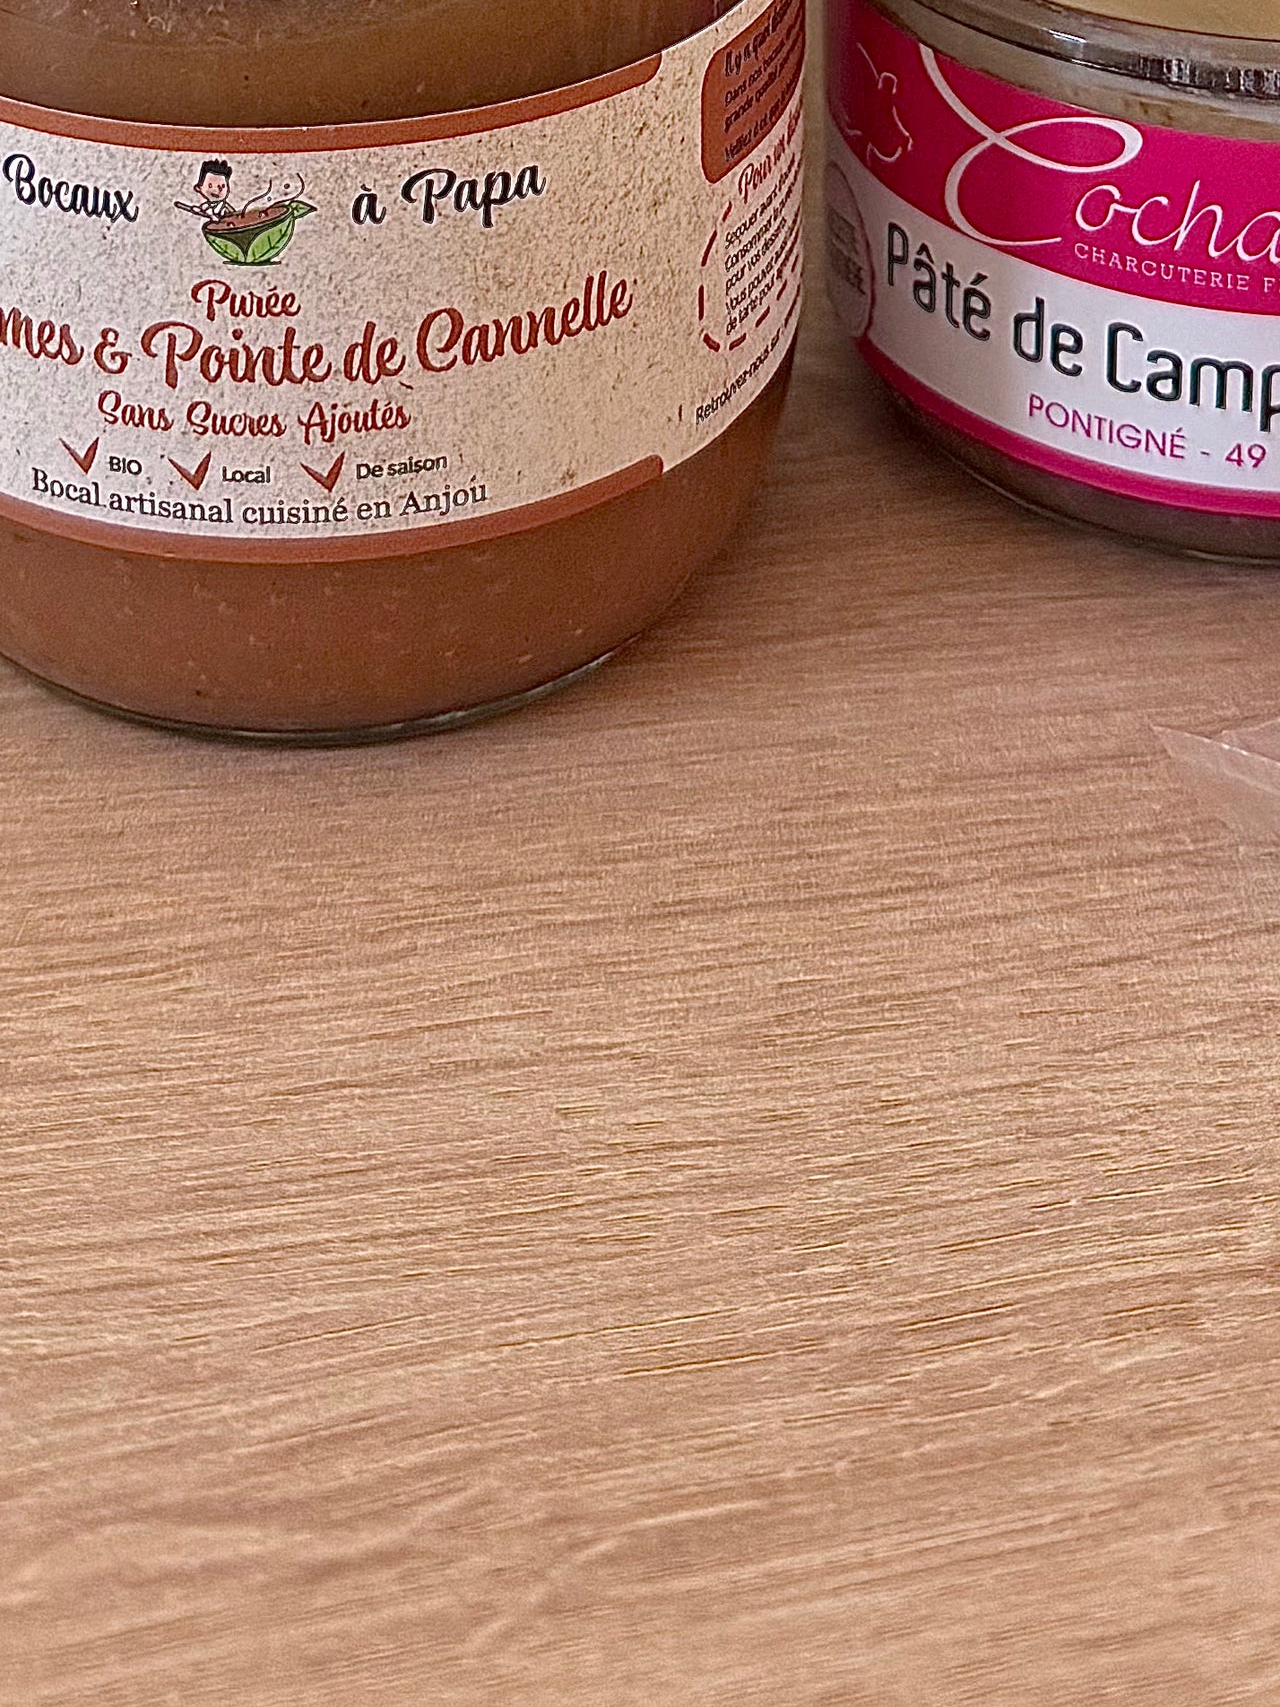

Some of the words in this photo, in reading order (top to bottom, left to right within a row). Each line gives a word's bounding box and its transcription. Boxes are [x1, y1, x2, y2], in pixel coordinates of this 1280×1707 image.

[3, 154, 139, 222] Bocaux
[352, 184, 386, 225] à
[402, 164, 547, 228] Papa
[1074, 243, 1249, 290] CHARCUTERIE
[190, 278, 300, 321] Purée
[887, 222, 992, 341] Pâté
[1013, 297, 1085, 378] de
[95, 331, 129, 375] &
[141, 321, 331, 390] Pointe
[344, 323, 406, 383] de
[418, 273, 634, 365] Cannelle
[97, 390, 173, 431] Sans
[187, 401, 287, 437] Sucres
[297, 399, 412, 445] Ajoutés
[1028, 392, 1188, 460] PONTIGNÉ
[1224, 442, 1267, 469] 49
[31, 467, 101, 506] Bocal
[109, 489, 232, 524] artisanal
[242, 498, 348, 524] cuisiné
[356, 501, 391, 520] en
[399, 477, 487, 516] Anjou
[109, 456, 142, 475] BIO
[222, 466, 271, 483] Local
[356, 461, 385, 479] De
[387, 456, 448, 476] saison
